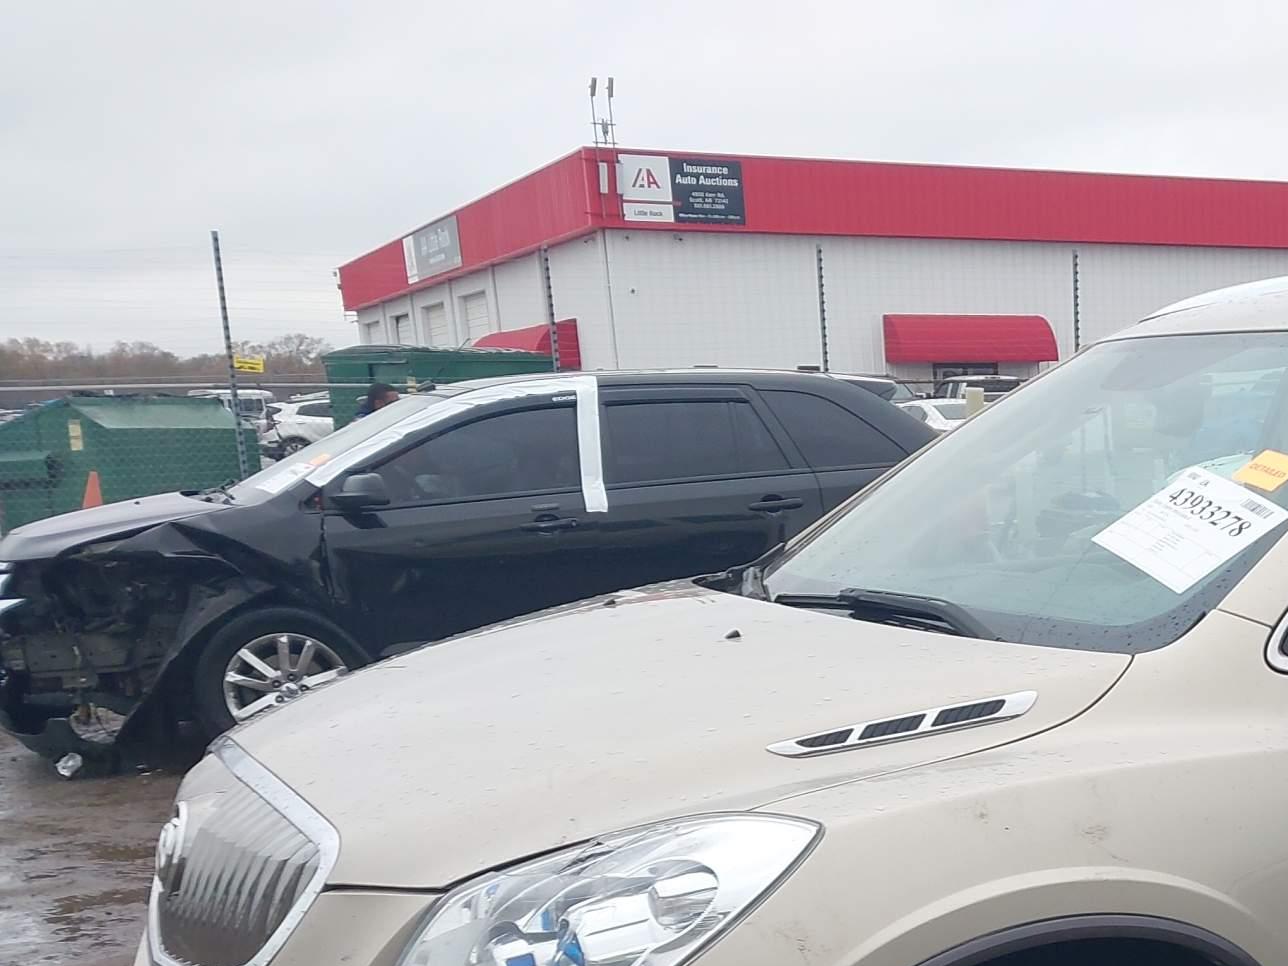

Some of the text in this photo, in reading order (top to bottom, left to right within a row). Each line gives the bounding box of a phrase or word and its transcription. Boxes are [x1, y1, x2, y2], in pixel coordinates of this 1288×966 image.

[683, 163, 729, 174] Insurance
[675, 175, 739, 187] Auto Auctions
[1168, 487, 1252, 537] 43933278
